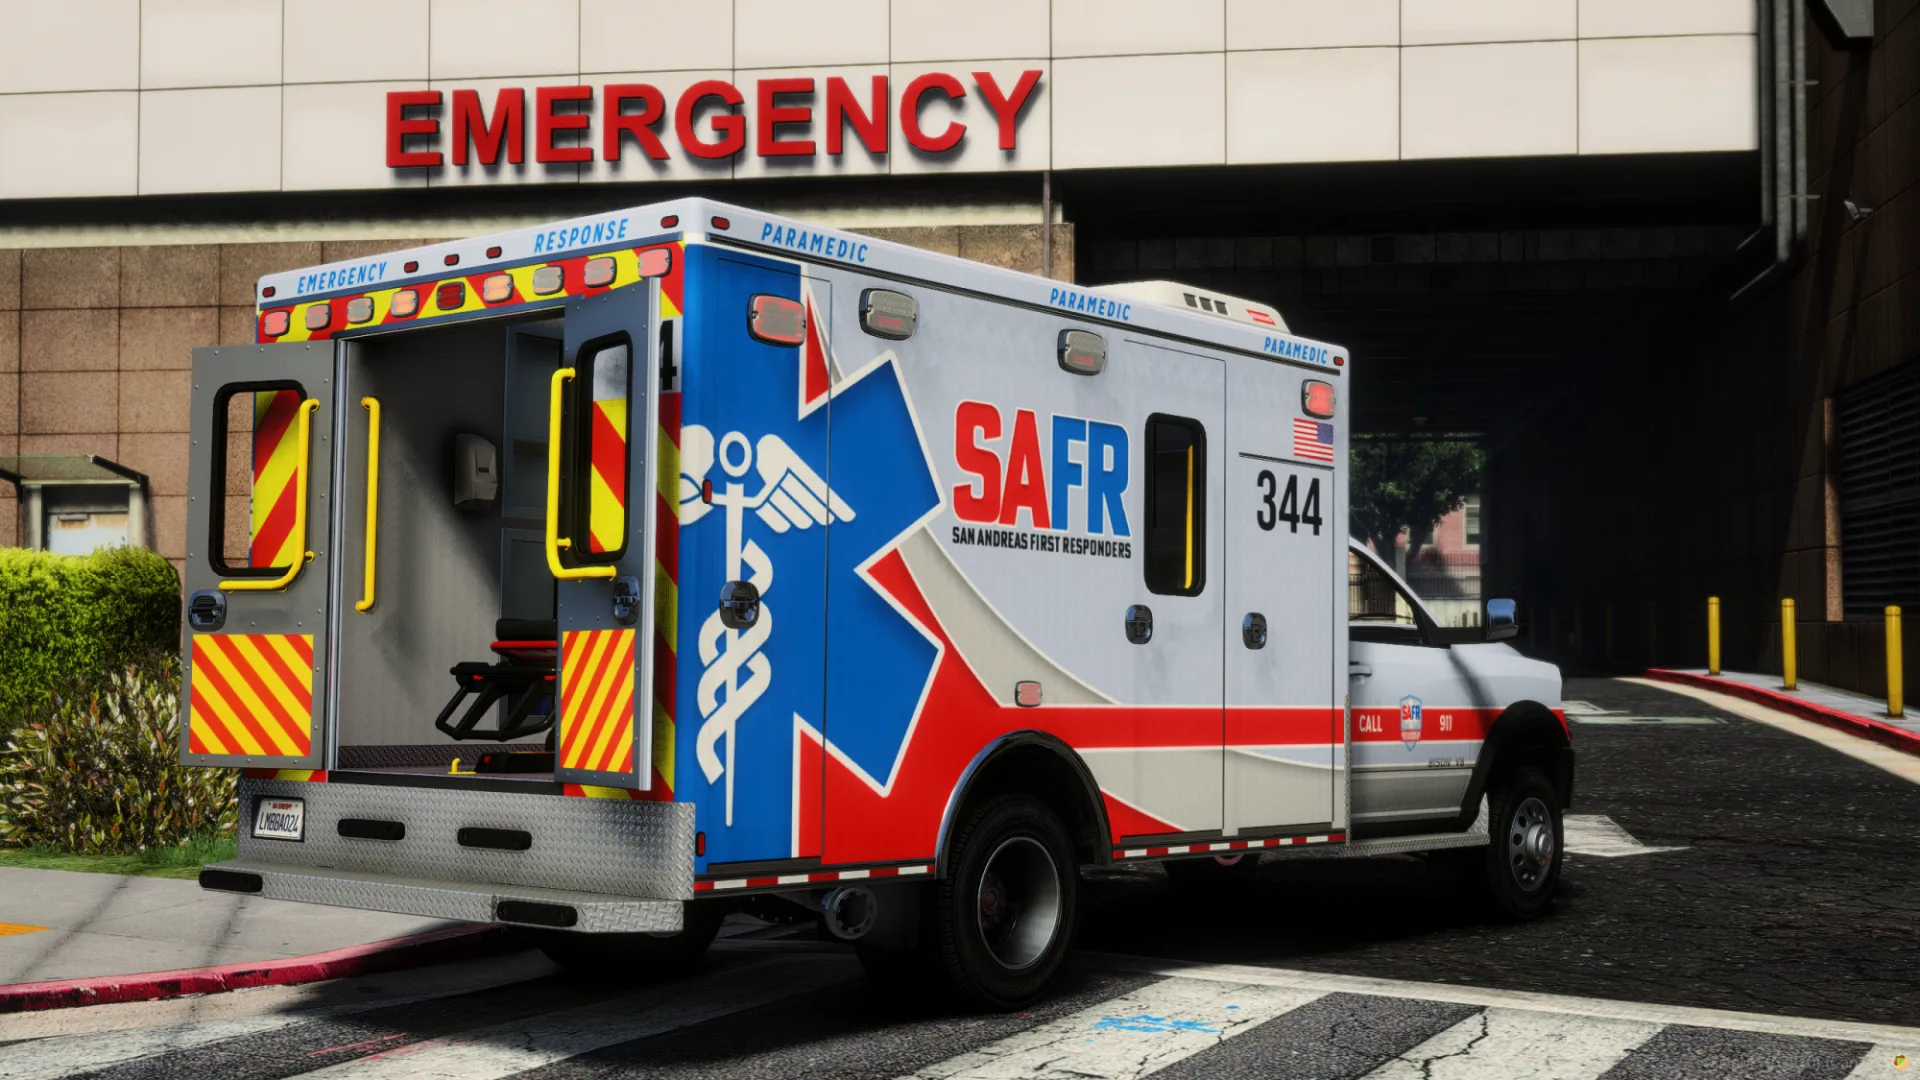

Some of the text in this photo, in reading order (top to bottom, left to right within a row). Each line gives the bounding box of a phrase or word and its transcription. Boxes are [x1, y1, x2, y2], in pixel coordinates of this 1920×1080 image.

[386, 70, 1043, 168] EMERGENCY
[534, 218, 629, 253] RESPONSE
[760, 222, 868, 263] PARAMEDIC
[297, 261, 387, 294] EMERGENCY
[1050, 288, 1131, 321] PARAMEDIC
[1263, 336, 1328, 366] PARAMEDIC
[952, 400, 1131, 537] SAFR
[1256, 469, 1322, 536] 344
[952, 526, 1132, 559] SAN ANDREAS FIRST RESPONDERS
[1359, 714, 1453, 732] CALL 911
[1402, 705, 1420, 720] SAFR
